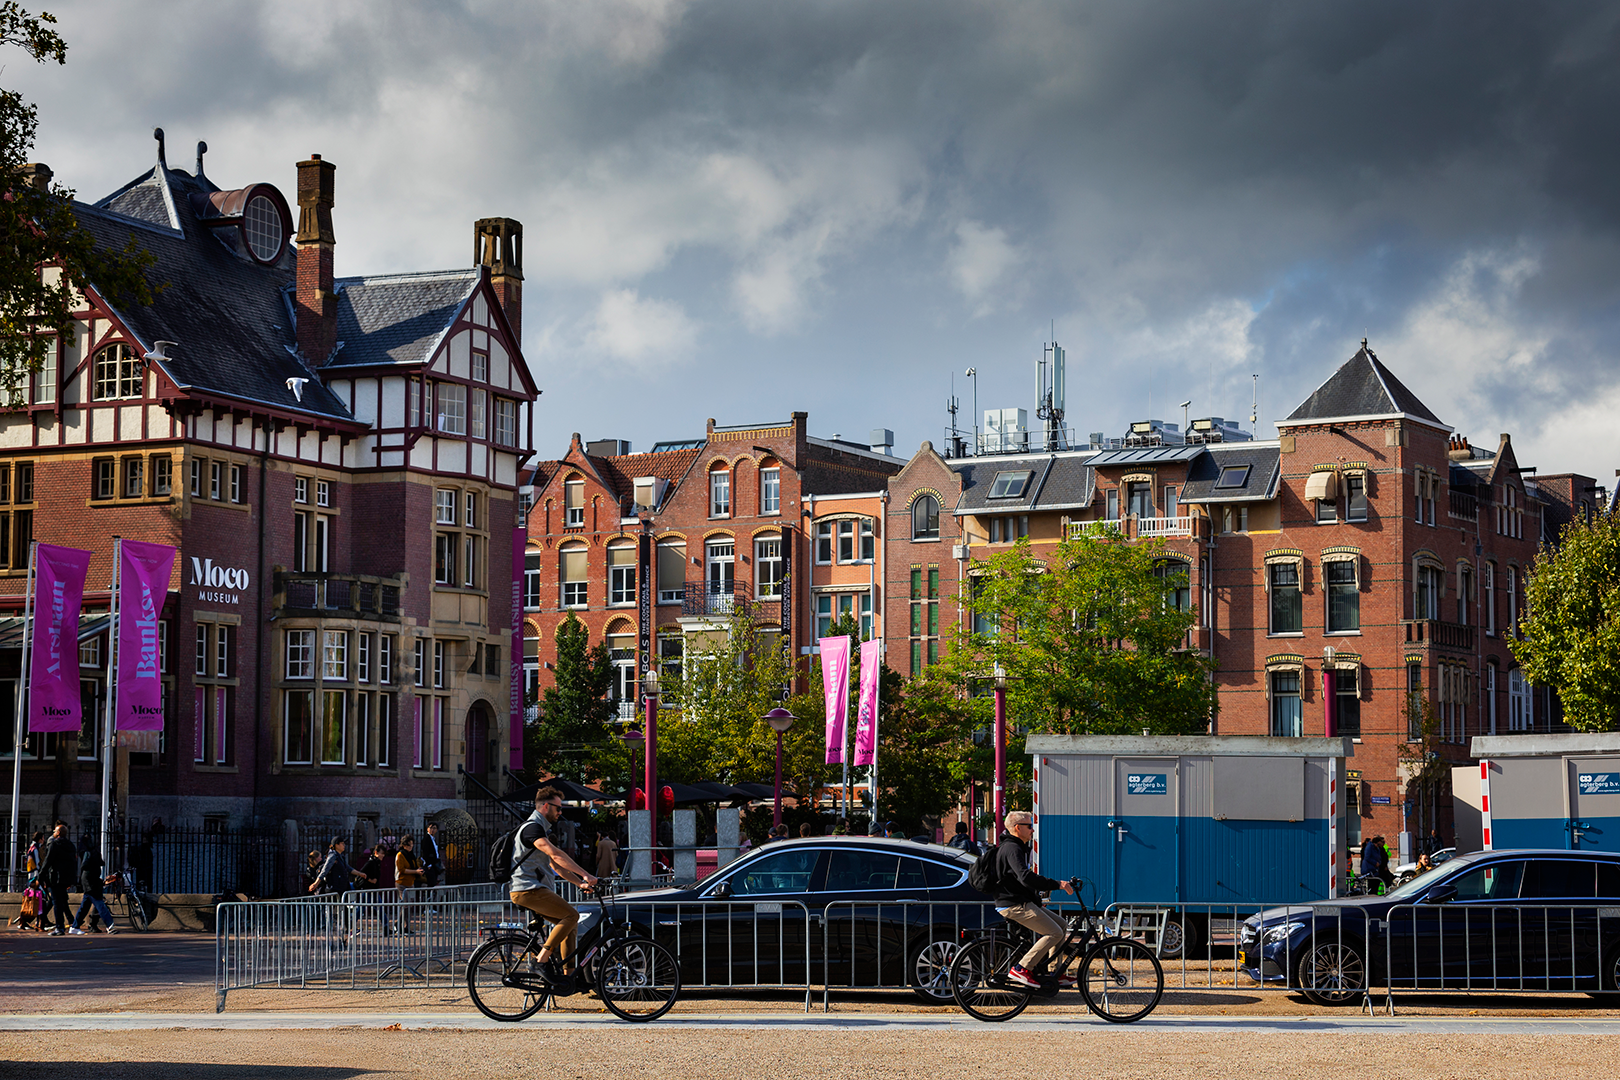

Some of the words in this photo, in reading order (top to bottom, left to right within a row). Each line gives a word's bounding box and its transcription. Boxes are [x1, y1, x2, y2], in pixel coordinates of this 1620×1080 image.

[189, 556, 250, 591] Moco
[198, 590, 239, 605] MUSEUM
[510, 580, 520, 638] Arsham
[46, 580, 67, 682] Arsham
[135, 581, 157, 680] Banksy
[641, 639, 649, 672] BOLS
[131, 705, 162, 715] Moco
[510, 660, 521, 715] Banksy
[827, 659, 837, 729] Arsham
[41, 706, 72, 716] Moco
